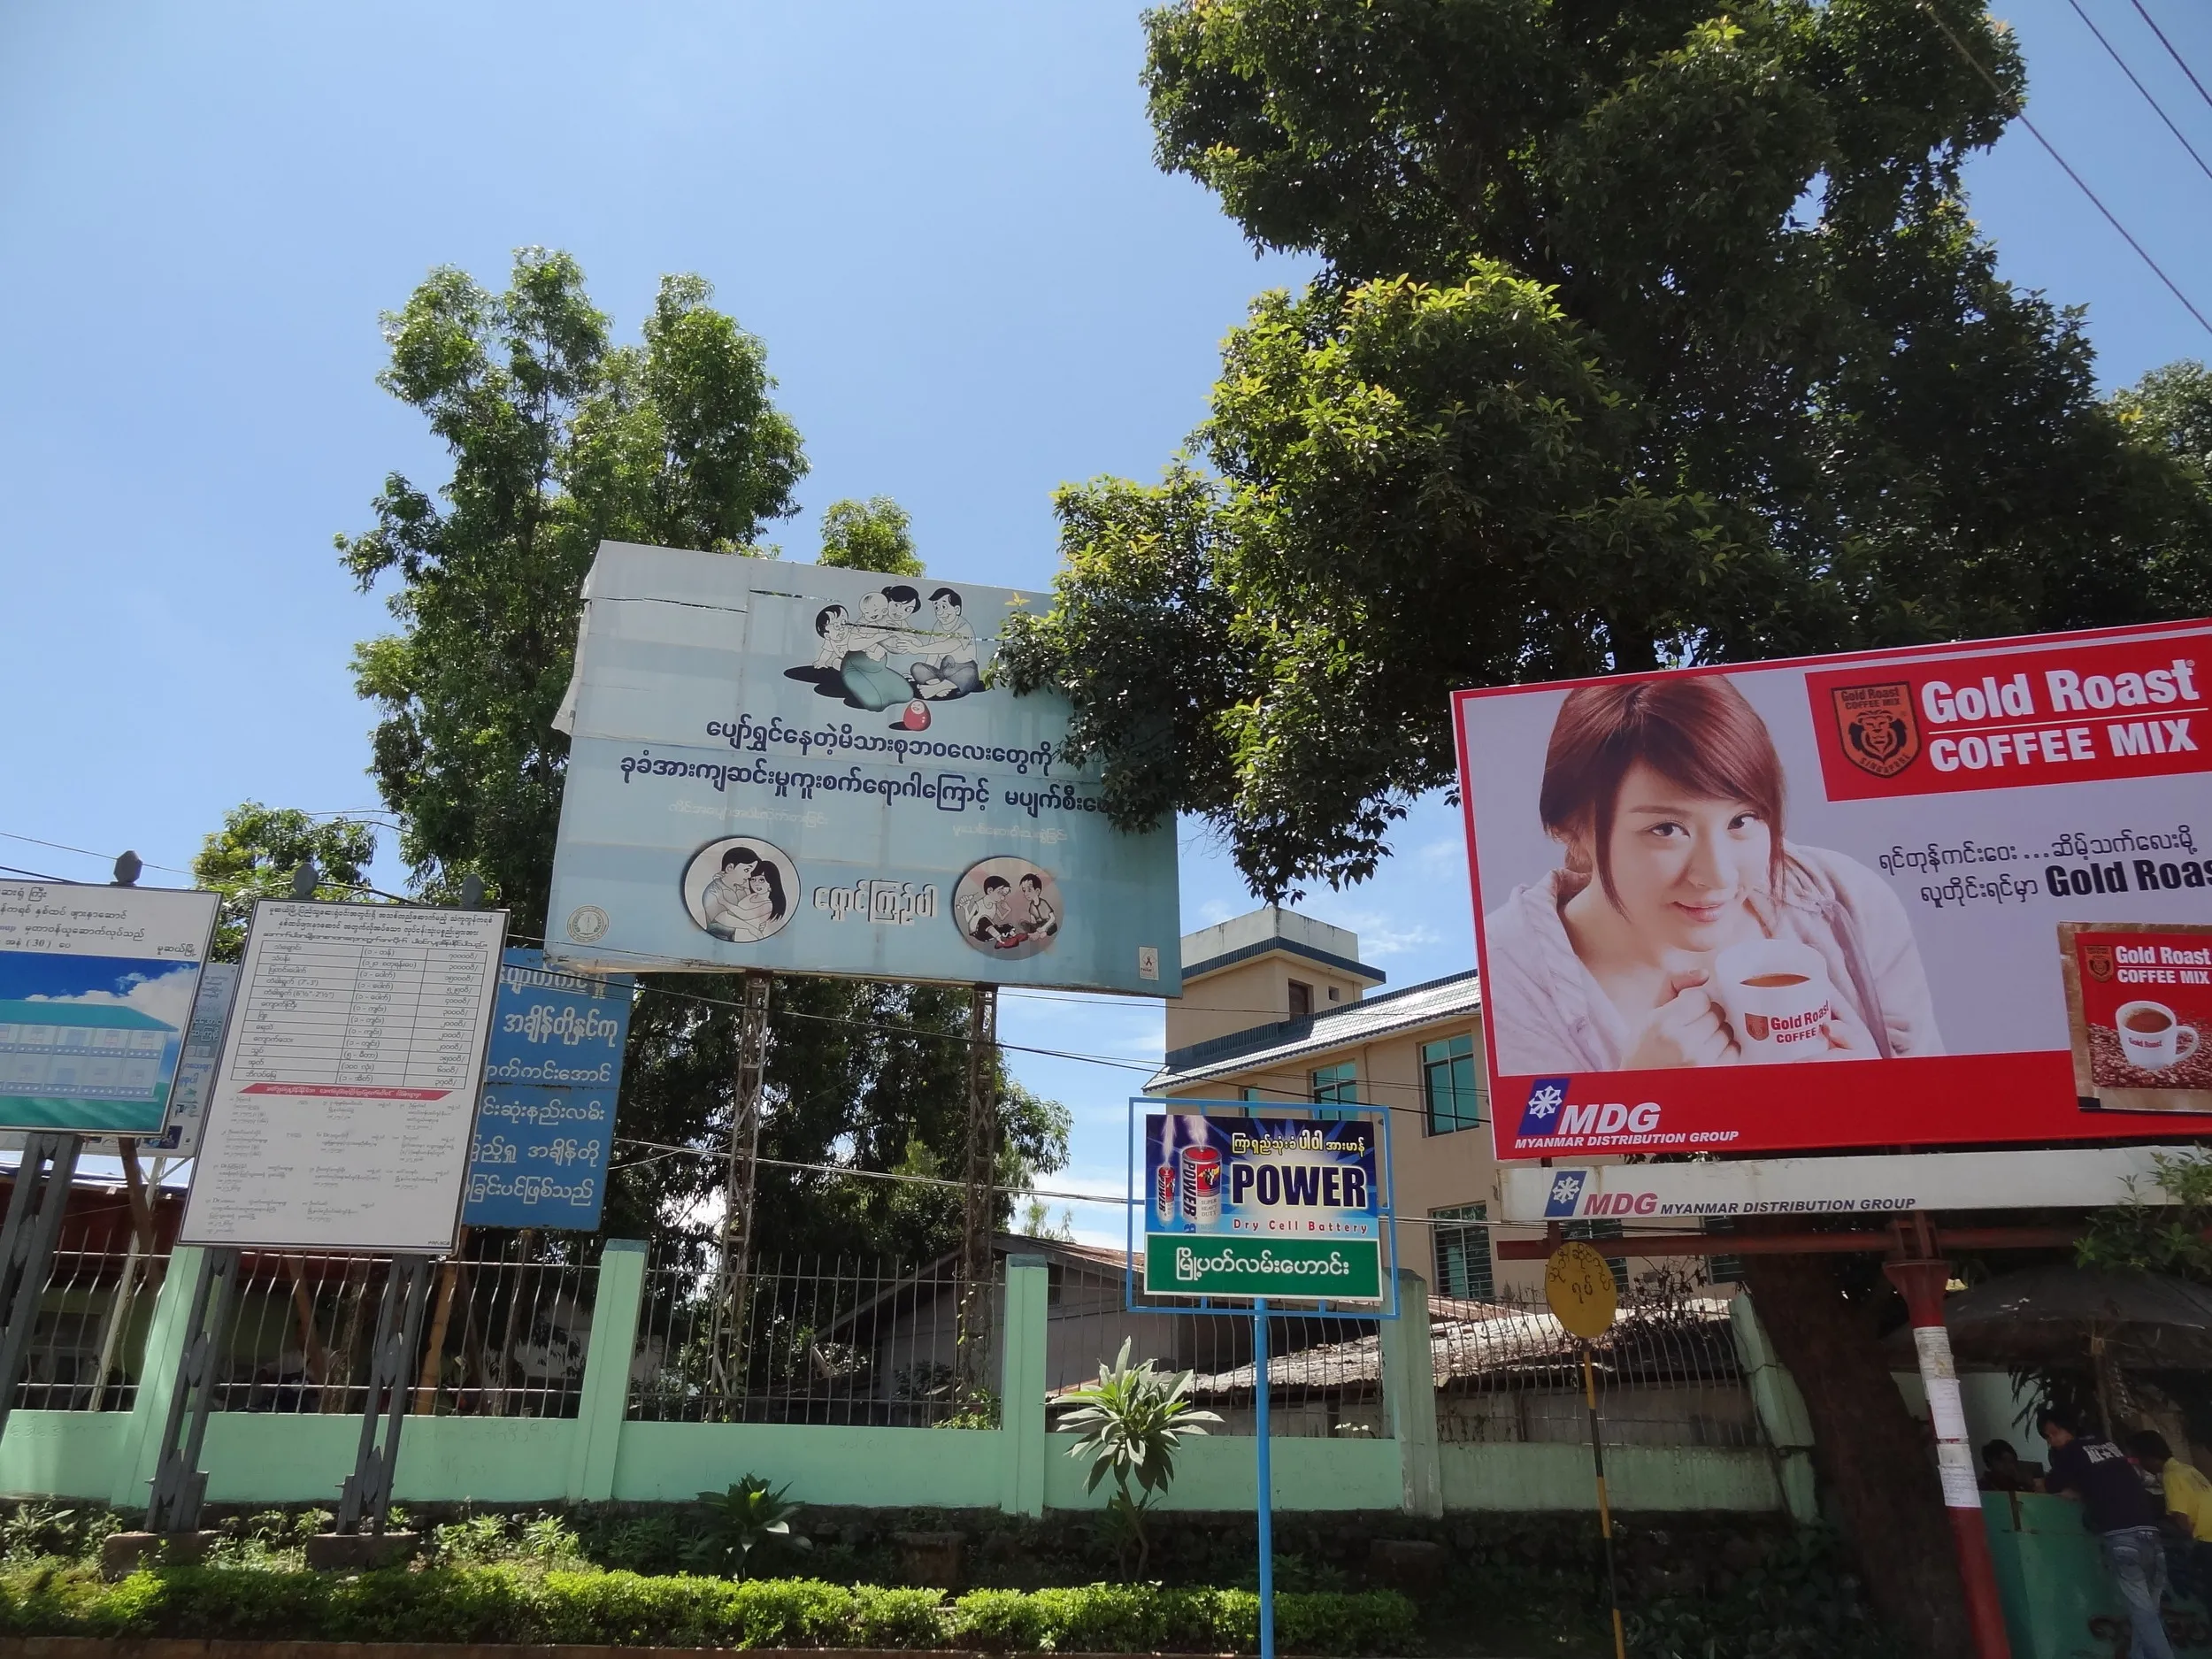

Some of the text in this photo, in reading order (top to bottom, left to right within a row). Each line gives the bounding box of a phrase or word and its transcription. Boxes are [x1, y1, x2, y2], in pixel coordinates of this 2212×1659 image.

[1921, 658, 2200, 724] Gold Roast
[1929, 718, 2199, 772] COFFEE MIX
[2045, 861, 2129, 897] Gold
[2116, 945, 2155, 964] Gold
[2160, 946, 2212, 965] Roast
[2117, 969, 2210, 985] COFFEE MIX
[1770, 1015, 1802, 1031] Gold
[1776, 1027, 1816, 1043] COFFEE
[1557, 1102, 1661, 1134] MDG
[1515, 1131, 1739, 1148] MYANMAR DISTRIBUTION GROUP
[1183, 1160, 1197, 1217] POWER
[1232, 1164, 1366, 1208] POWER
[1583, 1193, 1916, 1216] MDG MYANMAR DISTRIBUTION GROUP
[1233, 1218, 1367, 1233] Dry Cell Battery
